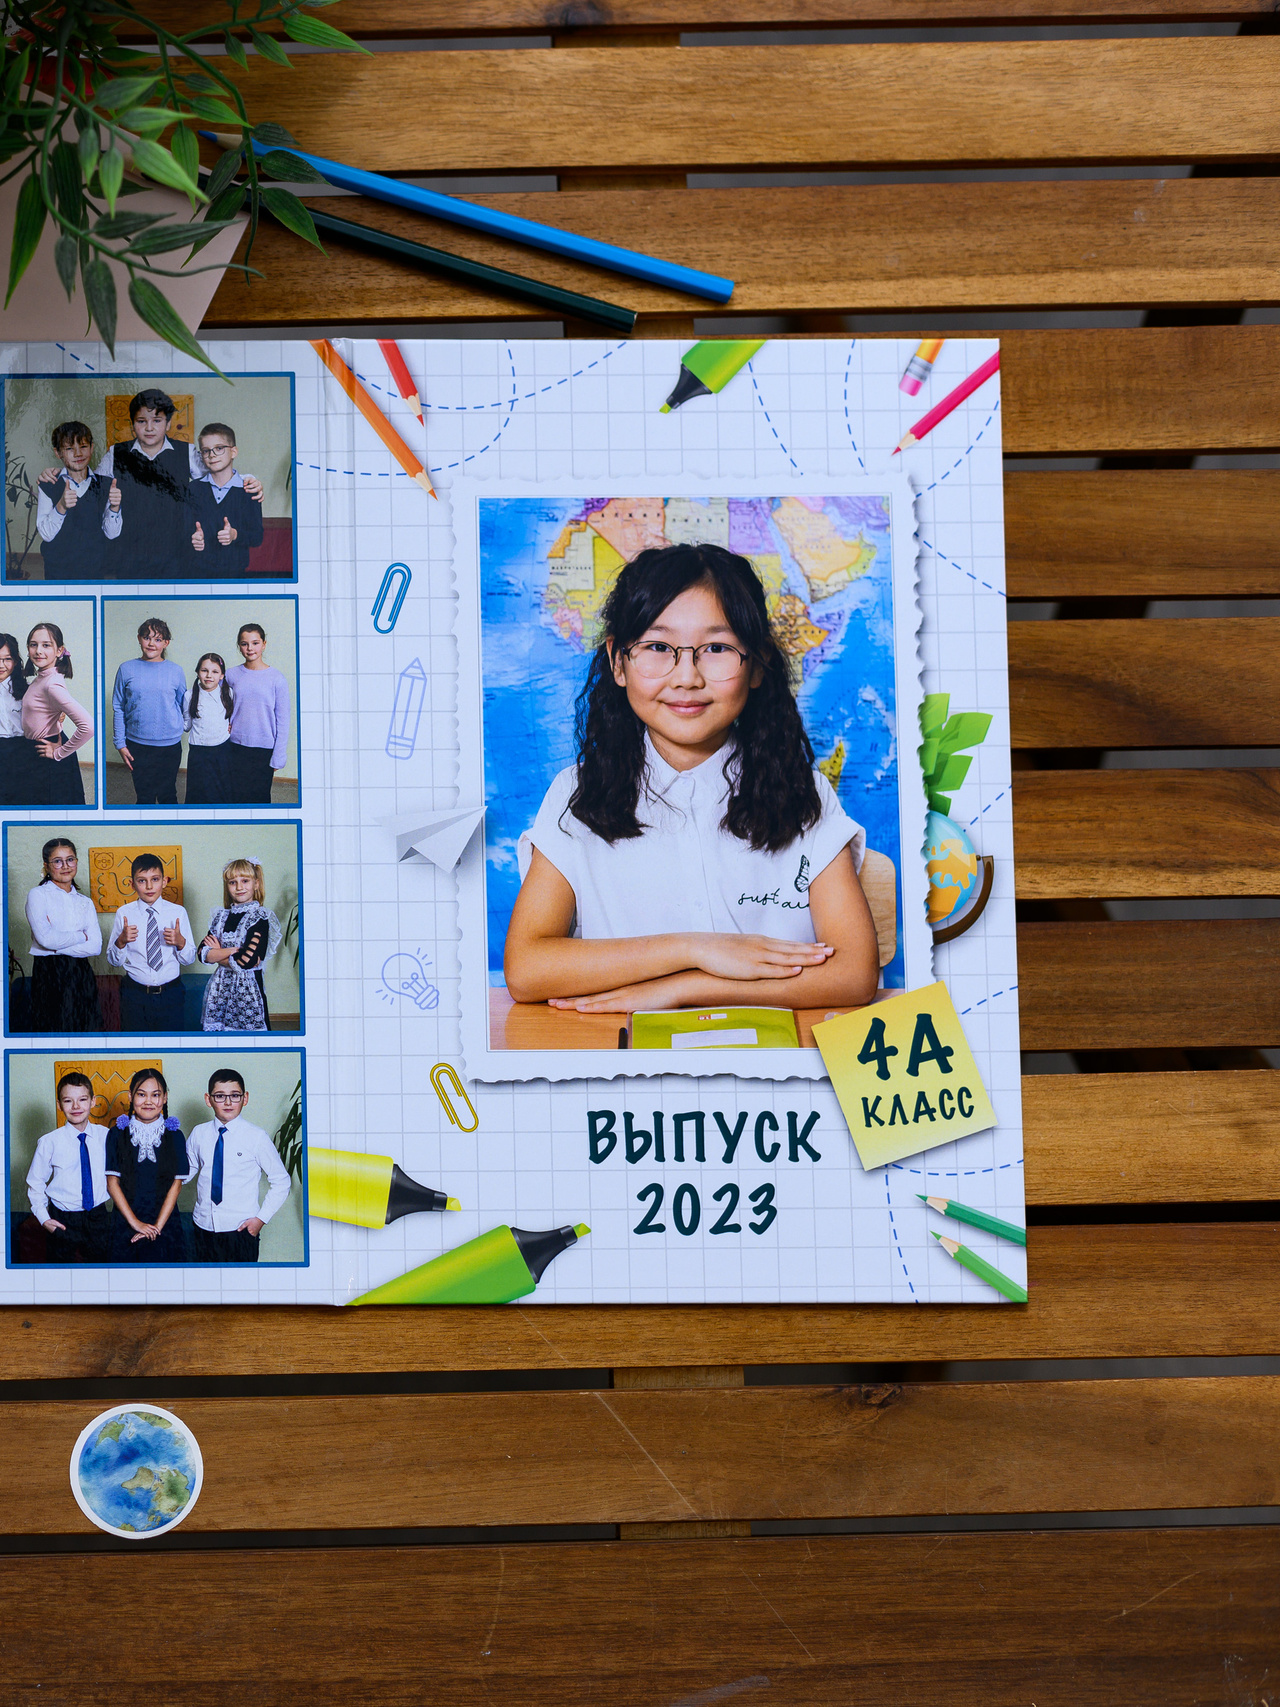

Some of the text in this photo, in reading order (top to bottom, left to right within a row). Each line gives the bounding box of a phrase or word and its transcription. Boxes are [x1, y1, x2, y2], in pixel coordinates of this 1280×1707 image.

[856, 1013, 956, 1082] 4А
[861, 1086, 976, 1129] КЛАСС
[586, 1109, 823, 1165] ВЫПУСК
[632, 1182, 779, 1237] 2023
